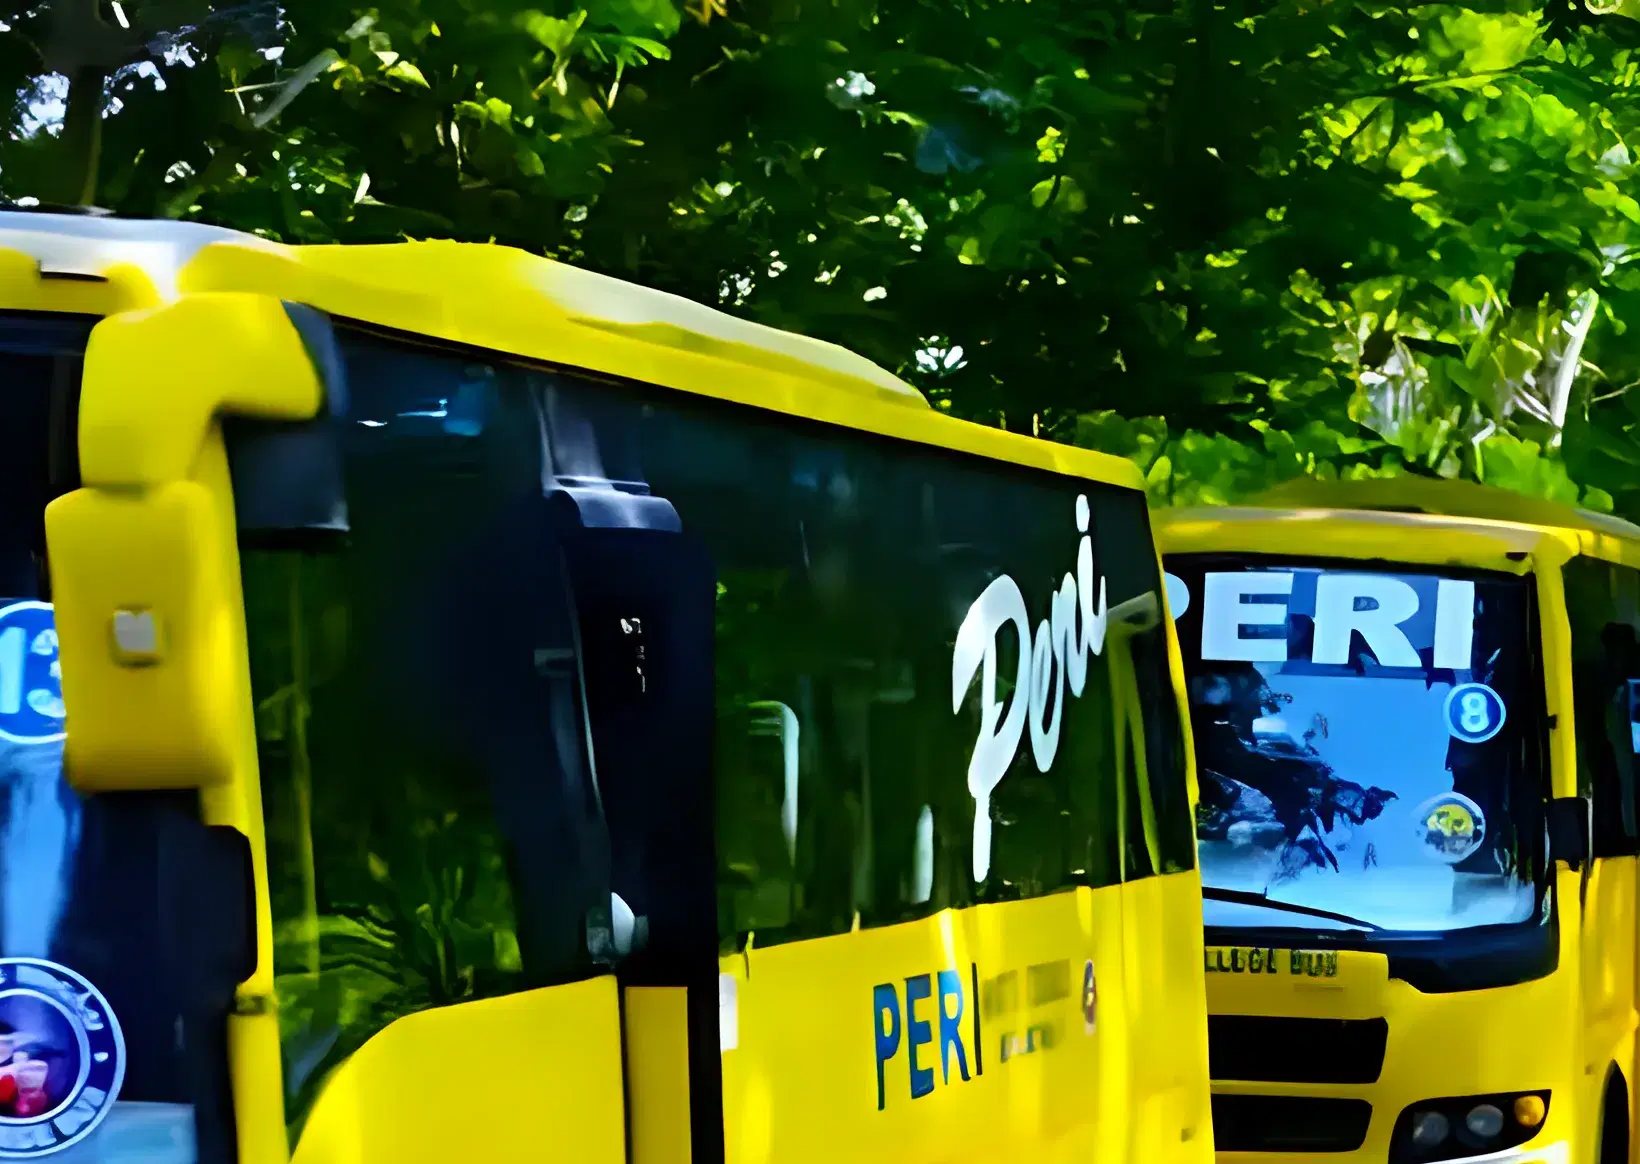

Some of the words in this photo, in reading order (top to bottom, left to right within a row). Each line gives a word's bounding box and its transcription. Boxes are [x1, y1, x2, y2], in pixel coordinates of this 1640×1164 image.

[952, 494, 1107, 883] Peri
[1460, 691, 1490, 733] 8
[872, 962, 983, 1112] PERI
